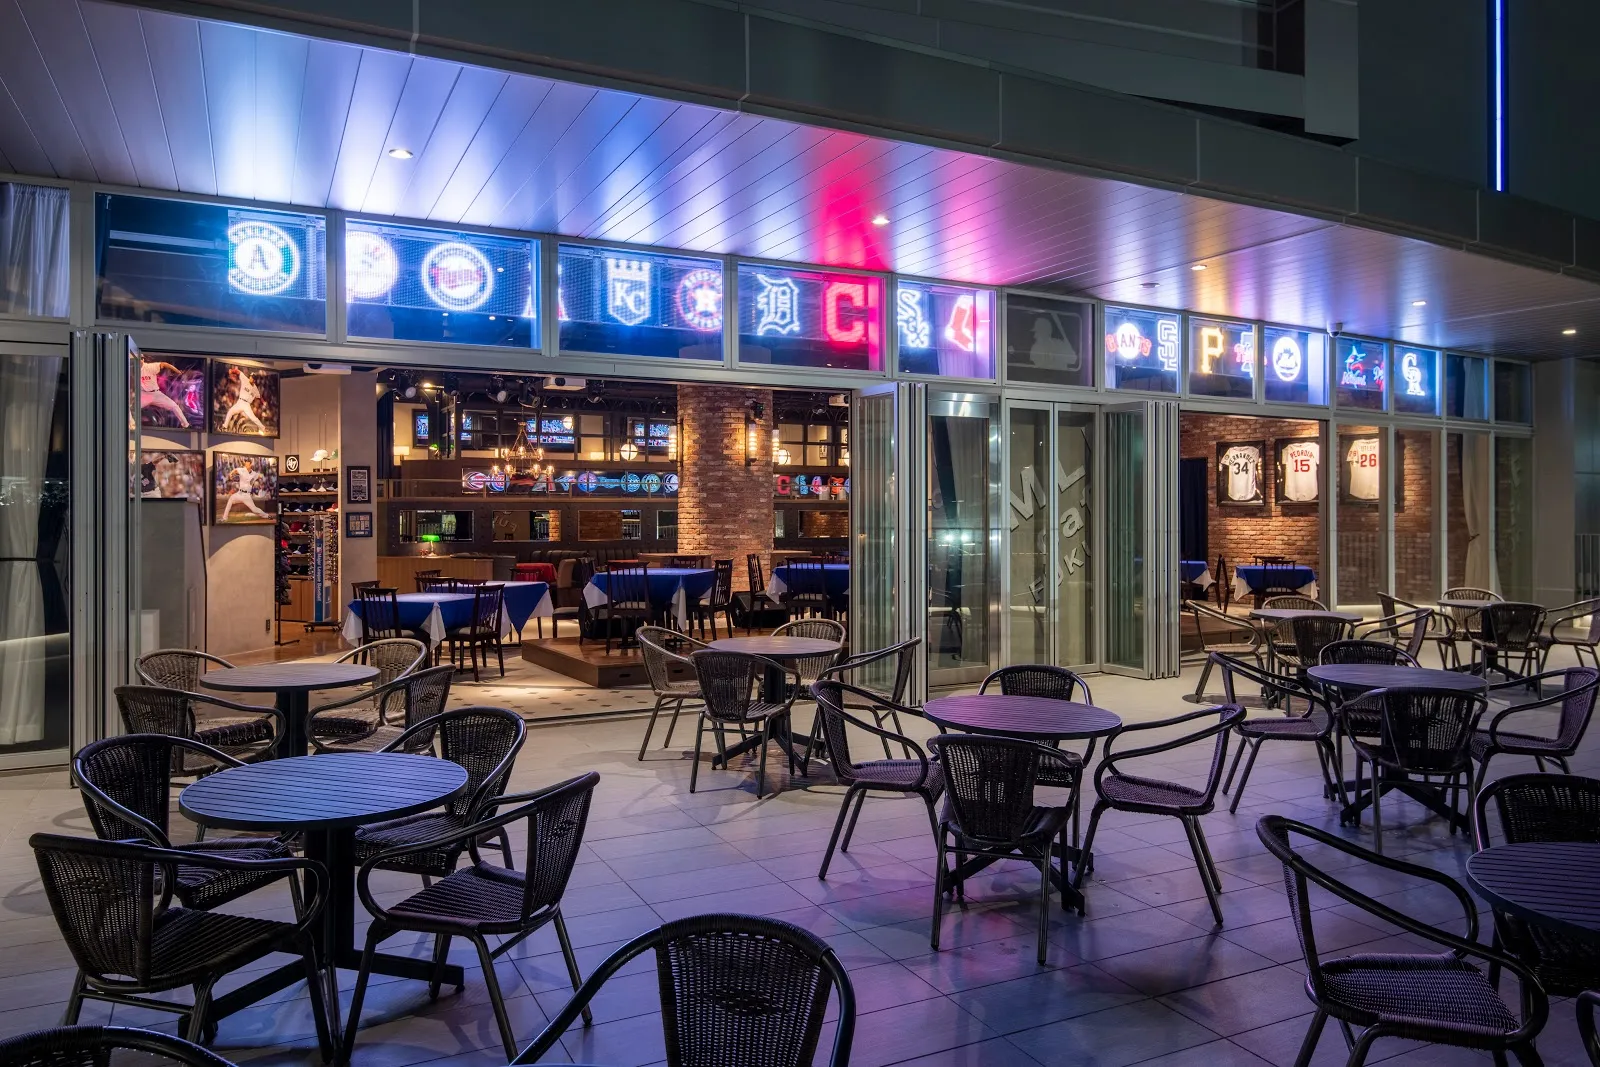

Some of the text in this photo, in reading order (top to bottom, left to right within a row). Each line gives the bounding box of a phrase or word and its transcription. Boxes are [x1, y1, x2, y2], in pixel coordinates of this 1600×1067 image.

[613, 281, 645, 315] KC
[826, 281, 865, 343] C
[1201, 327, 1224, 374] P
[1233, 461, 1249, 475] 34
[1294, 459, 1310, 473] 15
[1360, 453, 1377, 468] 26
